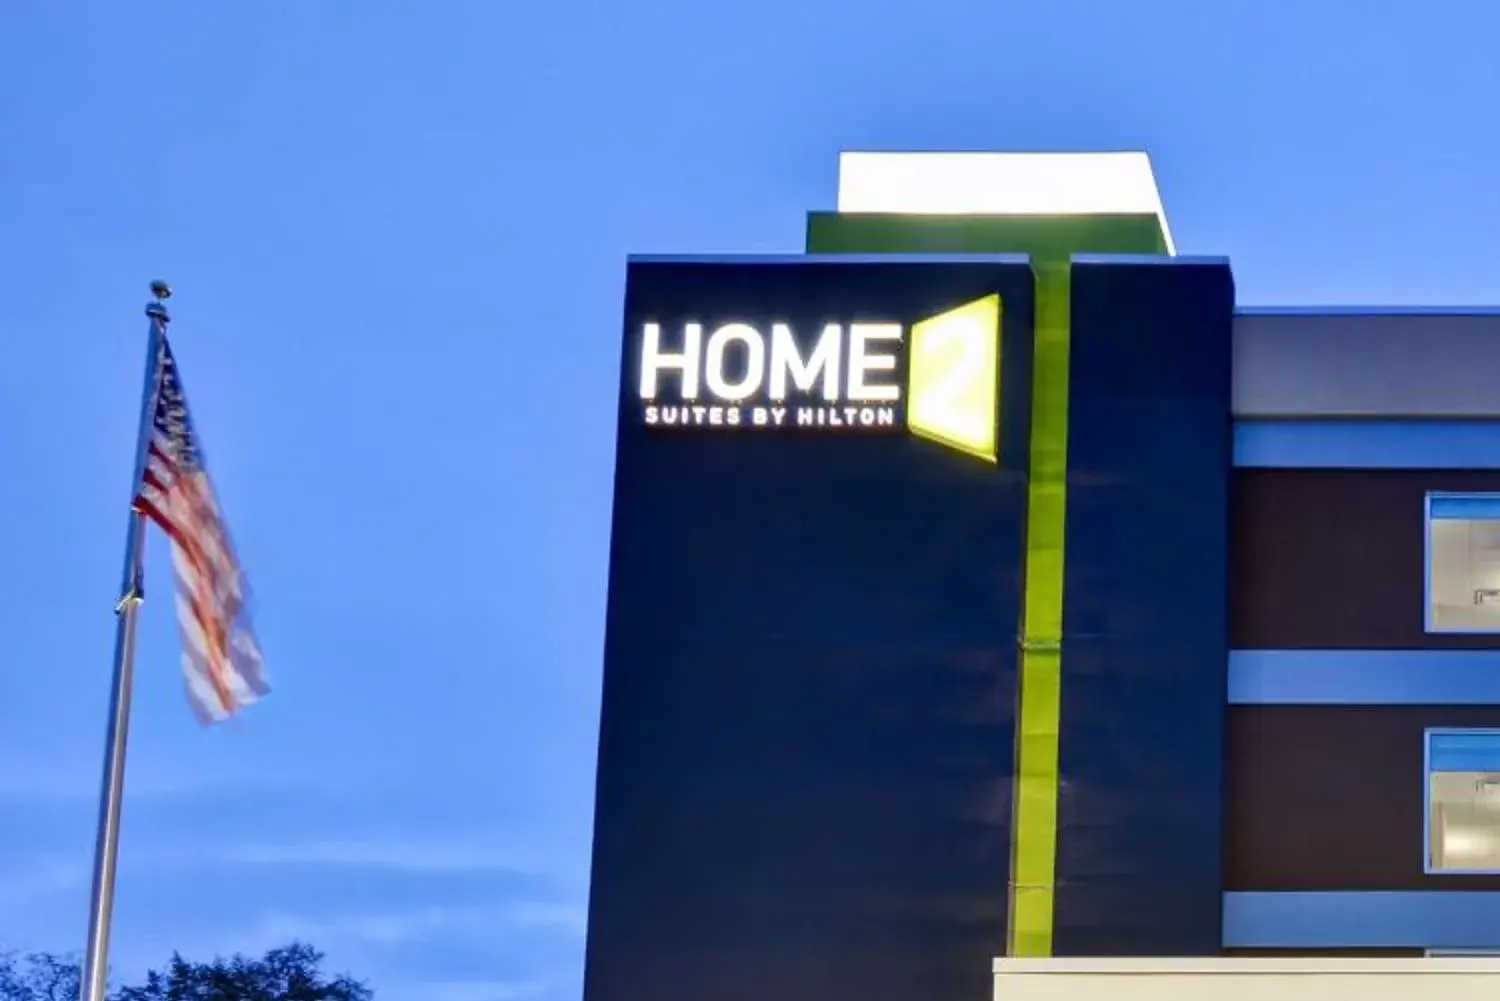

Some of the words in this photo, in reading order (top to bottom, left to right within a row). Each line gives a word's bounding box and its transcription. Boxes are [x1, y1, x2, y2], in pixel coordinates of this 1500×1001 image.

[639, 322, 902, 401] HOME
[914, 312, 990, 445] 2
[644, 406, 741, 426] SUITES
[752, 407, 787, 427] BY
[797, 407, 894, 427] HILTON
